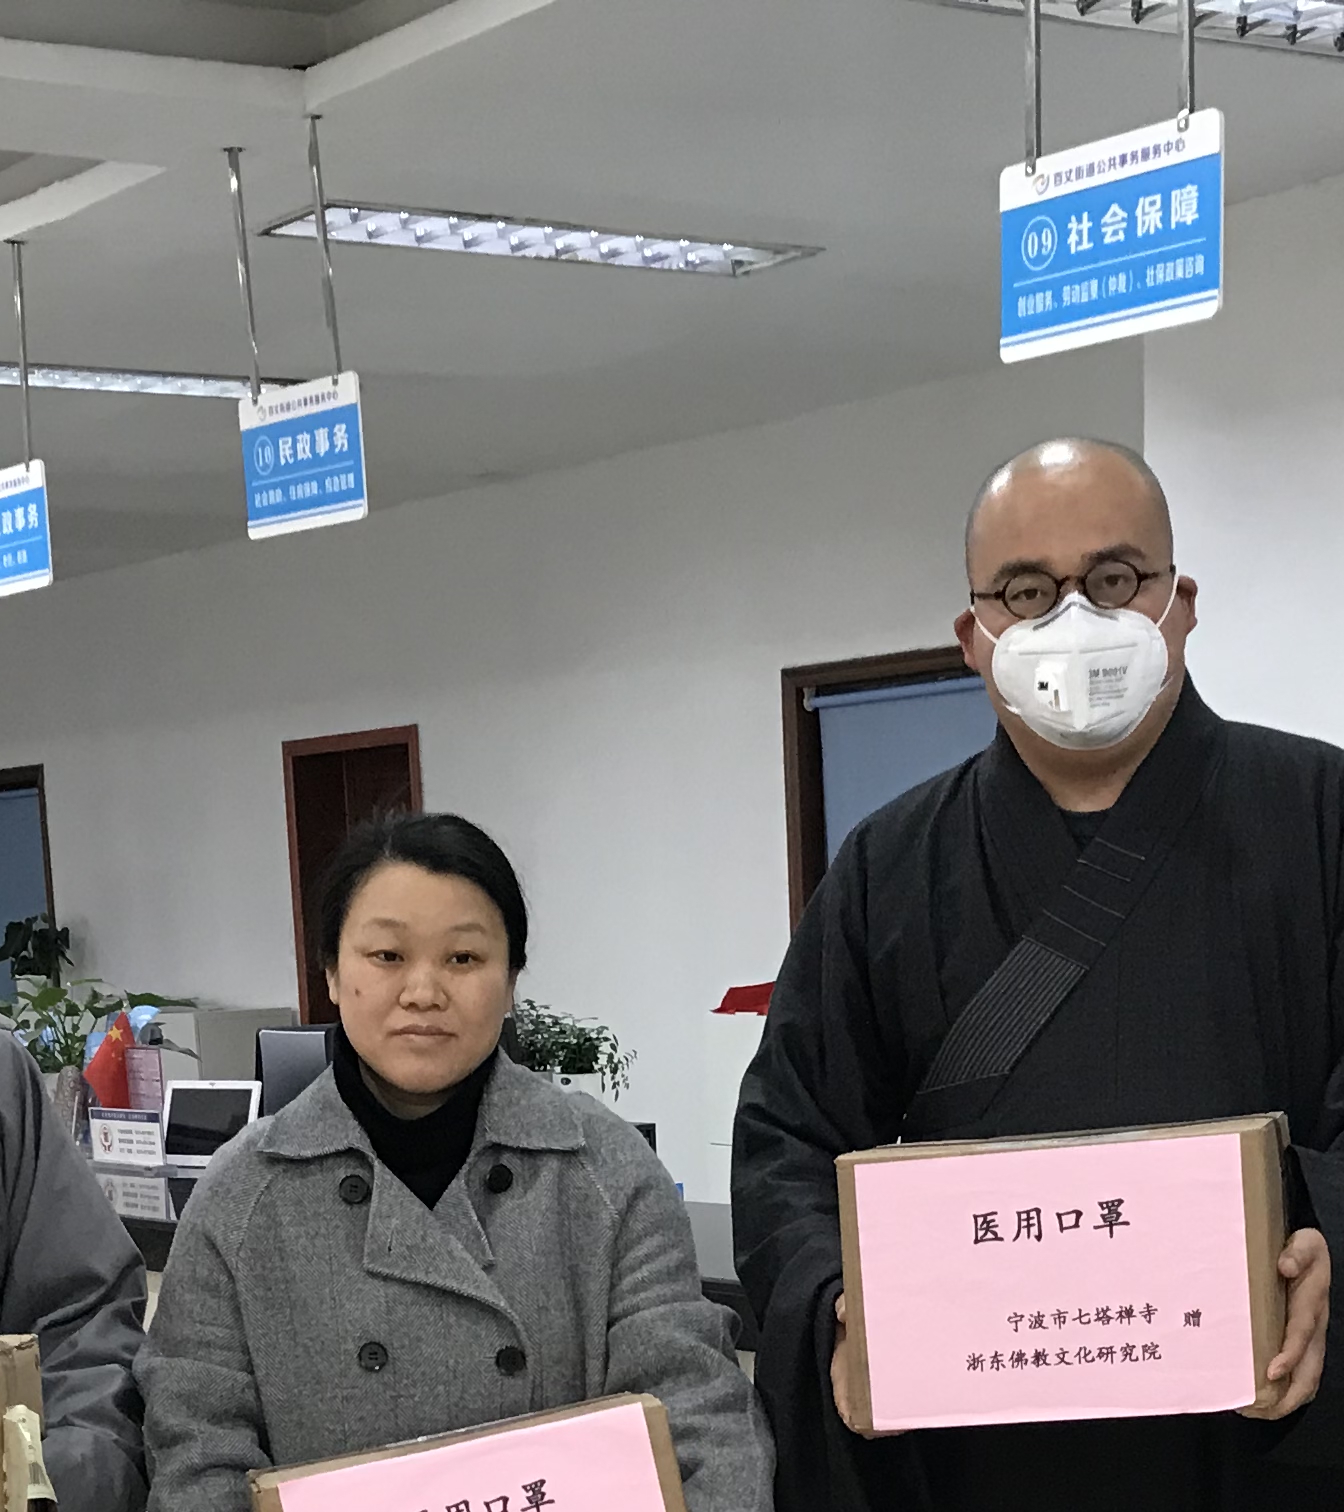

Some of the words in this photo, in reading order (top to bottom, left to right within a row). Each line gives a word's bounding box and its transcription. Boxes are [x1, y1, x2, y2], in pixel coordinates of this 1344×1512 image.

[1026, 226, 1053, 260] 09
[1066, 183, 1200, 255] 社会保障
[278, 423, 350, 467] 民政事务
[1038, 681, 1049, 690] 3M
[972, 1198, 1131, 1246] 医用口罩
[1007, 1302, 1158, 1333] 宁波市七塔禅寺
[1183, 1308, 1202, 1328] 赠
[966, 1341, 1162, 1372] 浙东佛教文化研究院
